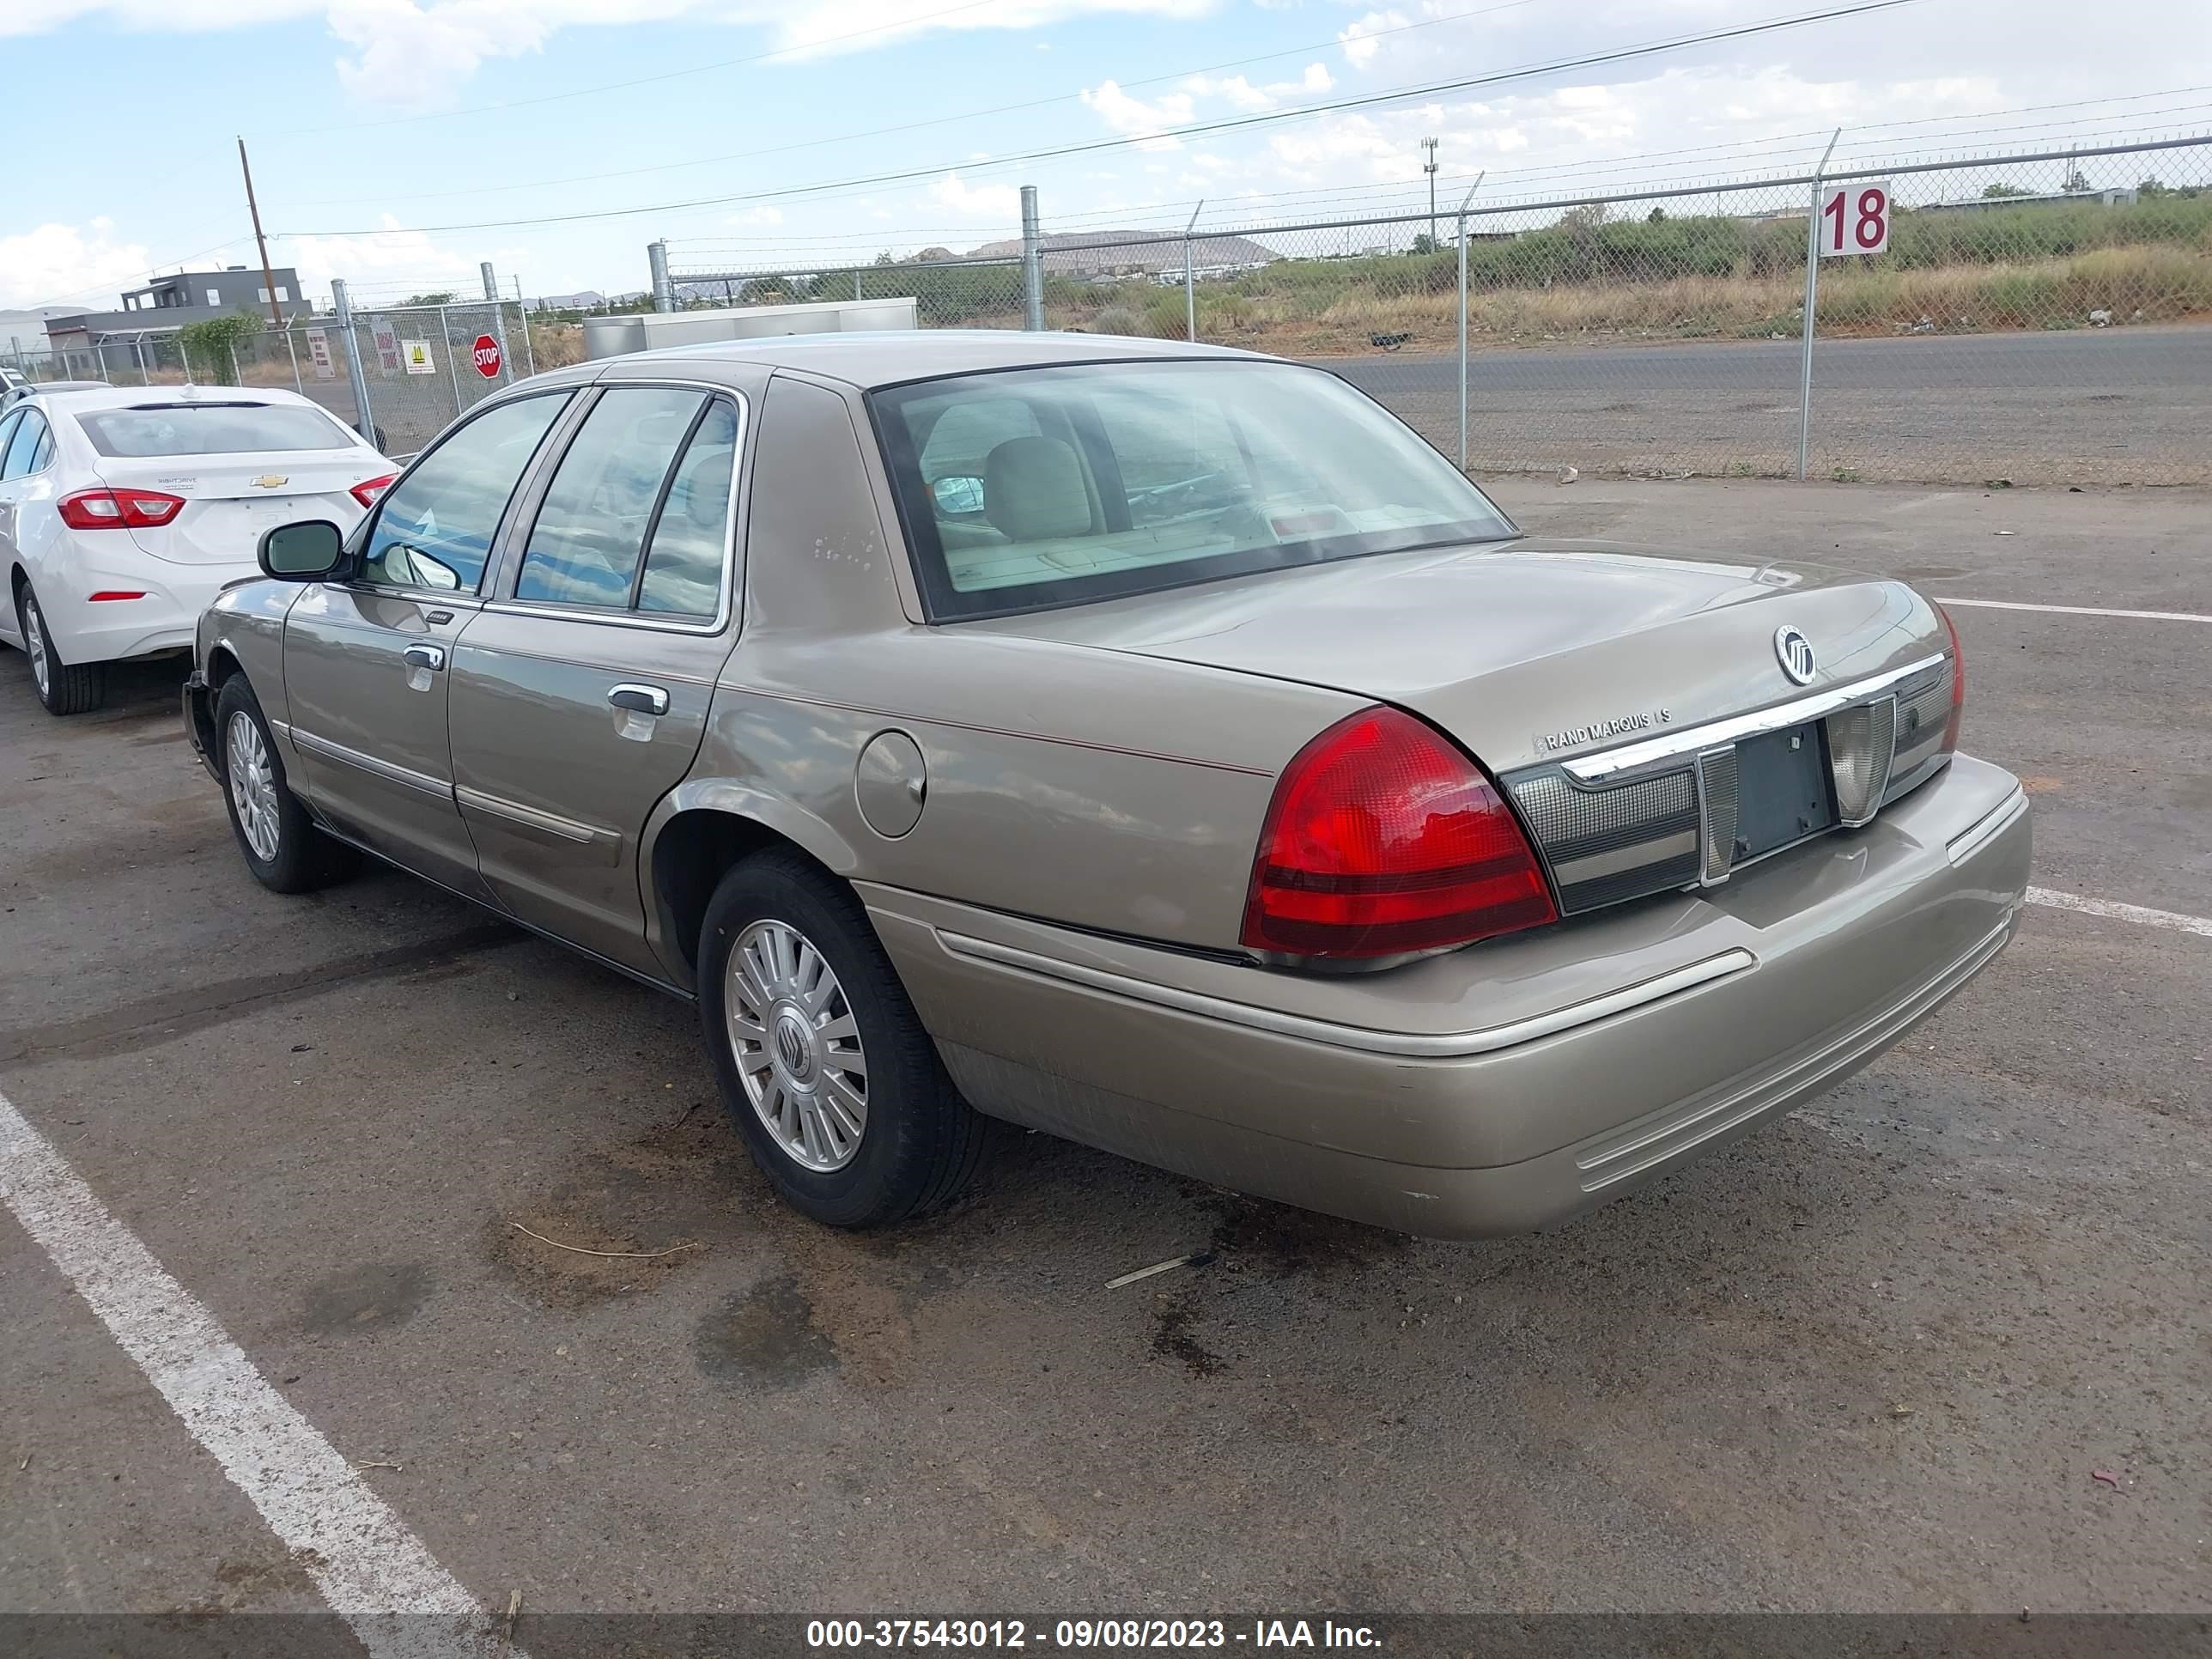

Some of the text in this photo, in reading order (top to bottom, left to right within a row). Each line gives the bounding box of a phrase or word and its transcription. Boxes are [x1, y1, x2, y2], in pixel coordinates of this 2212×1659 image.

[1825, 188, 1886, 251] 18
[475, 347, 498, 367] STOP
[1587, 713, 1650, 740] MARQUIS
